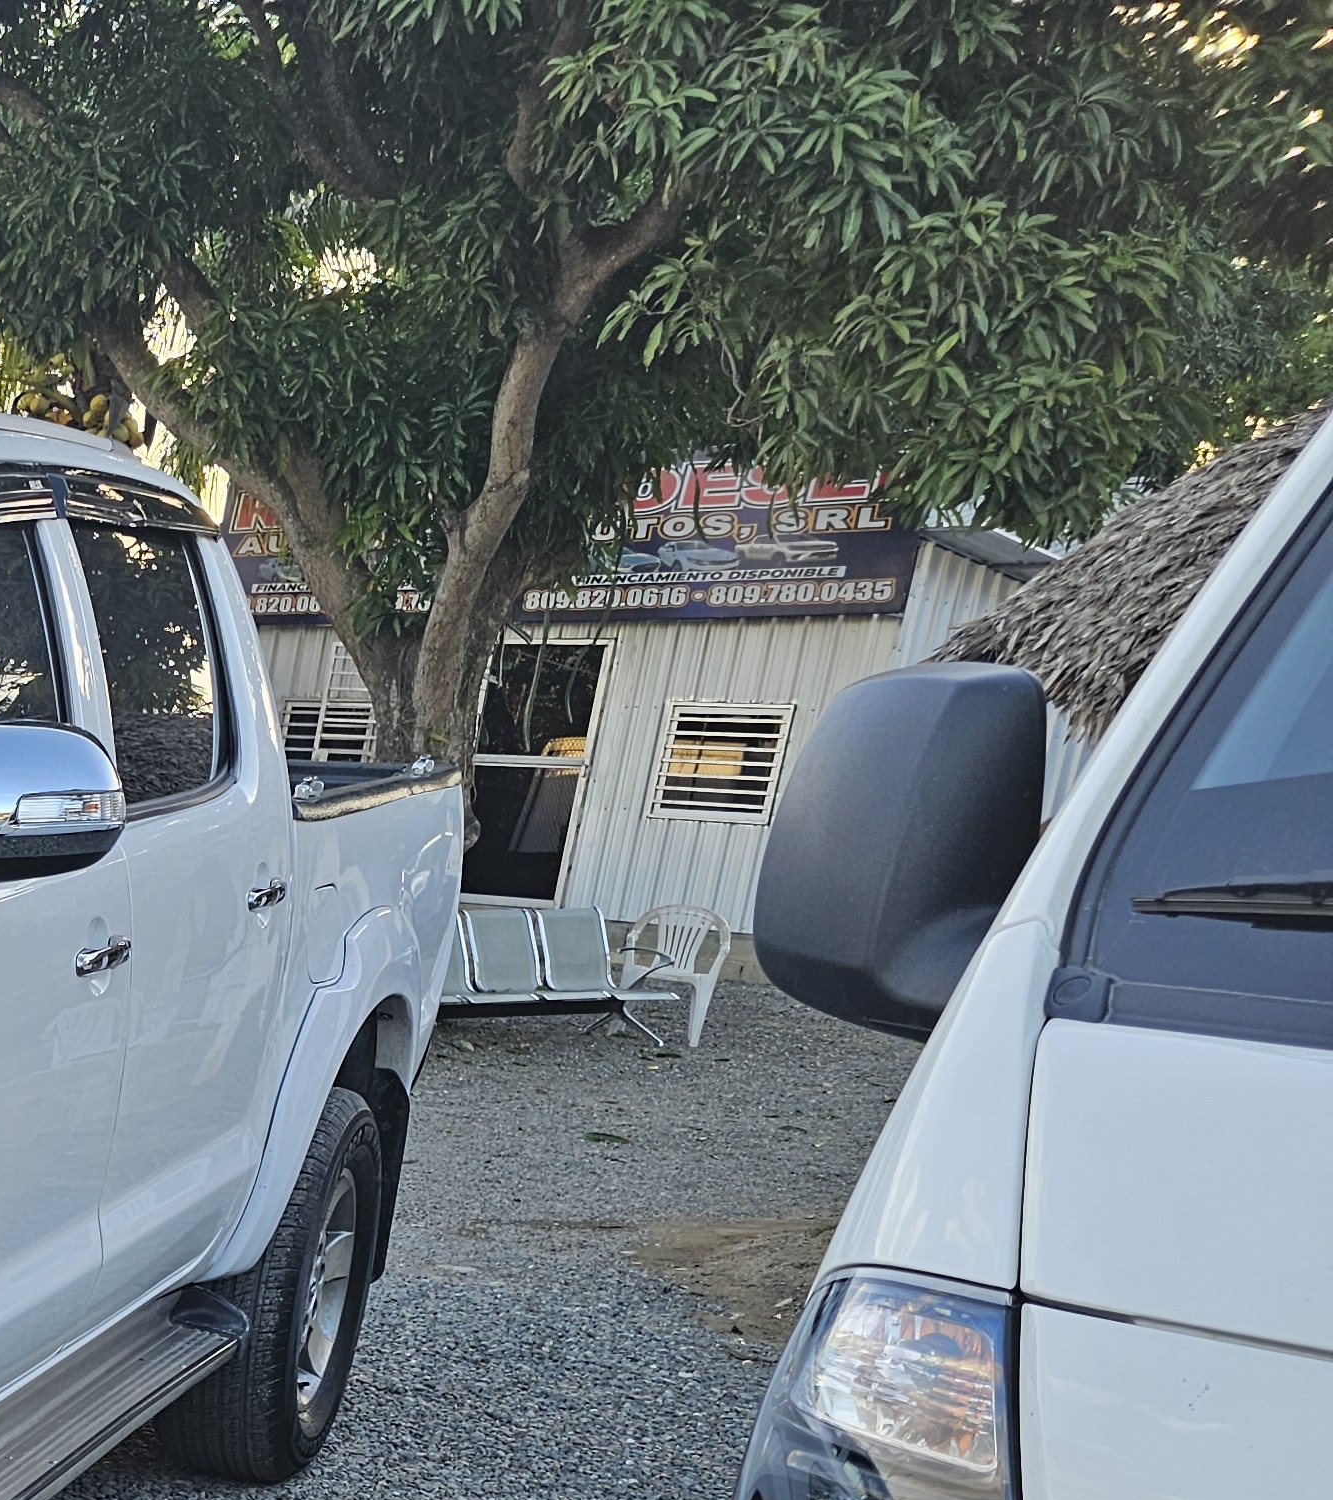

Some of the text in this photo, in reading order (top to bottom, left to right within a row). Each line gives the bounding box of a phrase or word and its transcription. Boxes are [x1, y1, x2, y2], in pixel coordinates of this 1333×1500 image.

[773, 506, 888, 534] SRL
[727, 566, 840, 581] DISPONIBLE
[524, 580, 893, 611] 809.820.0616 809.780.0435
